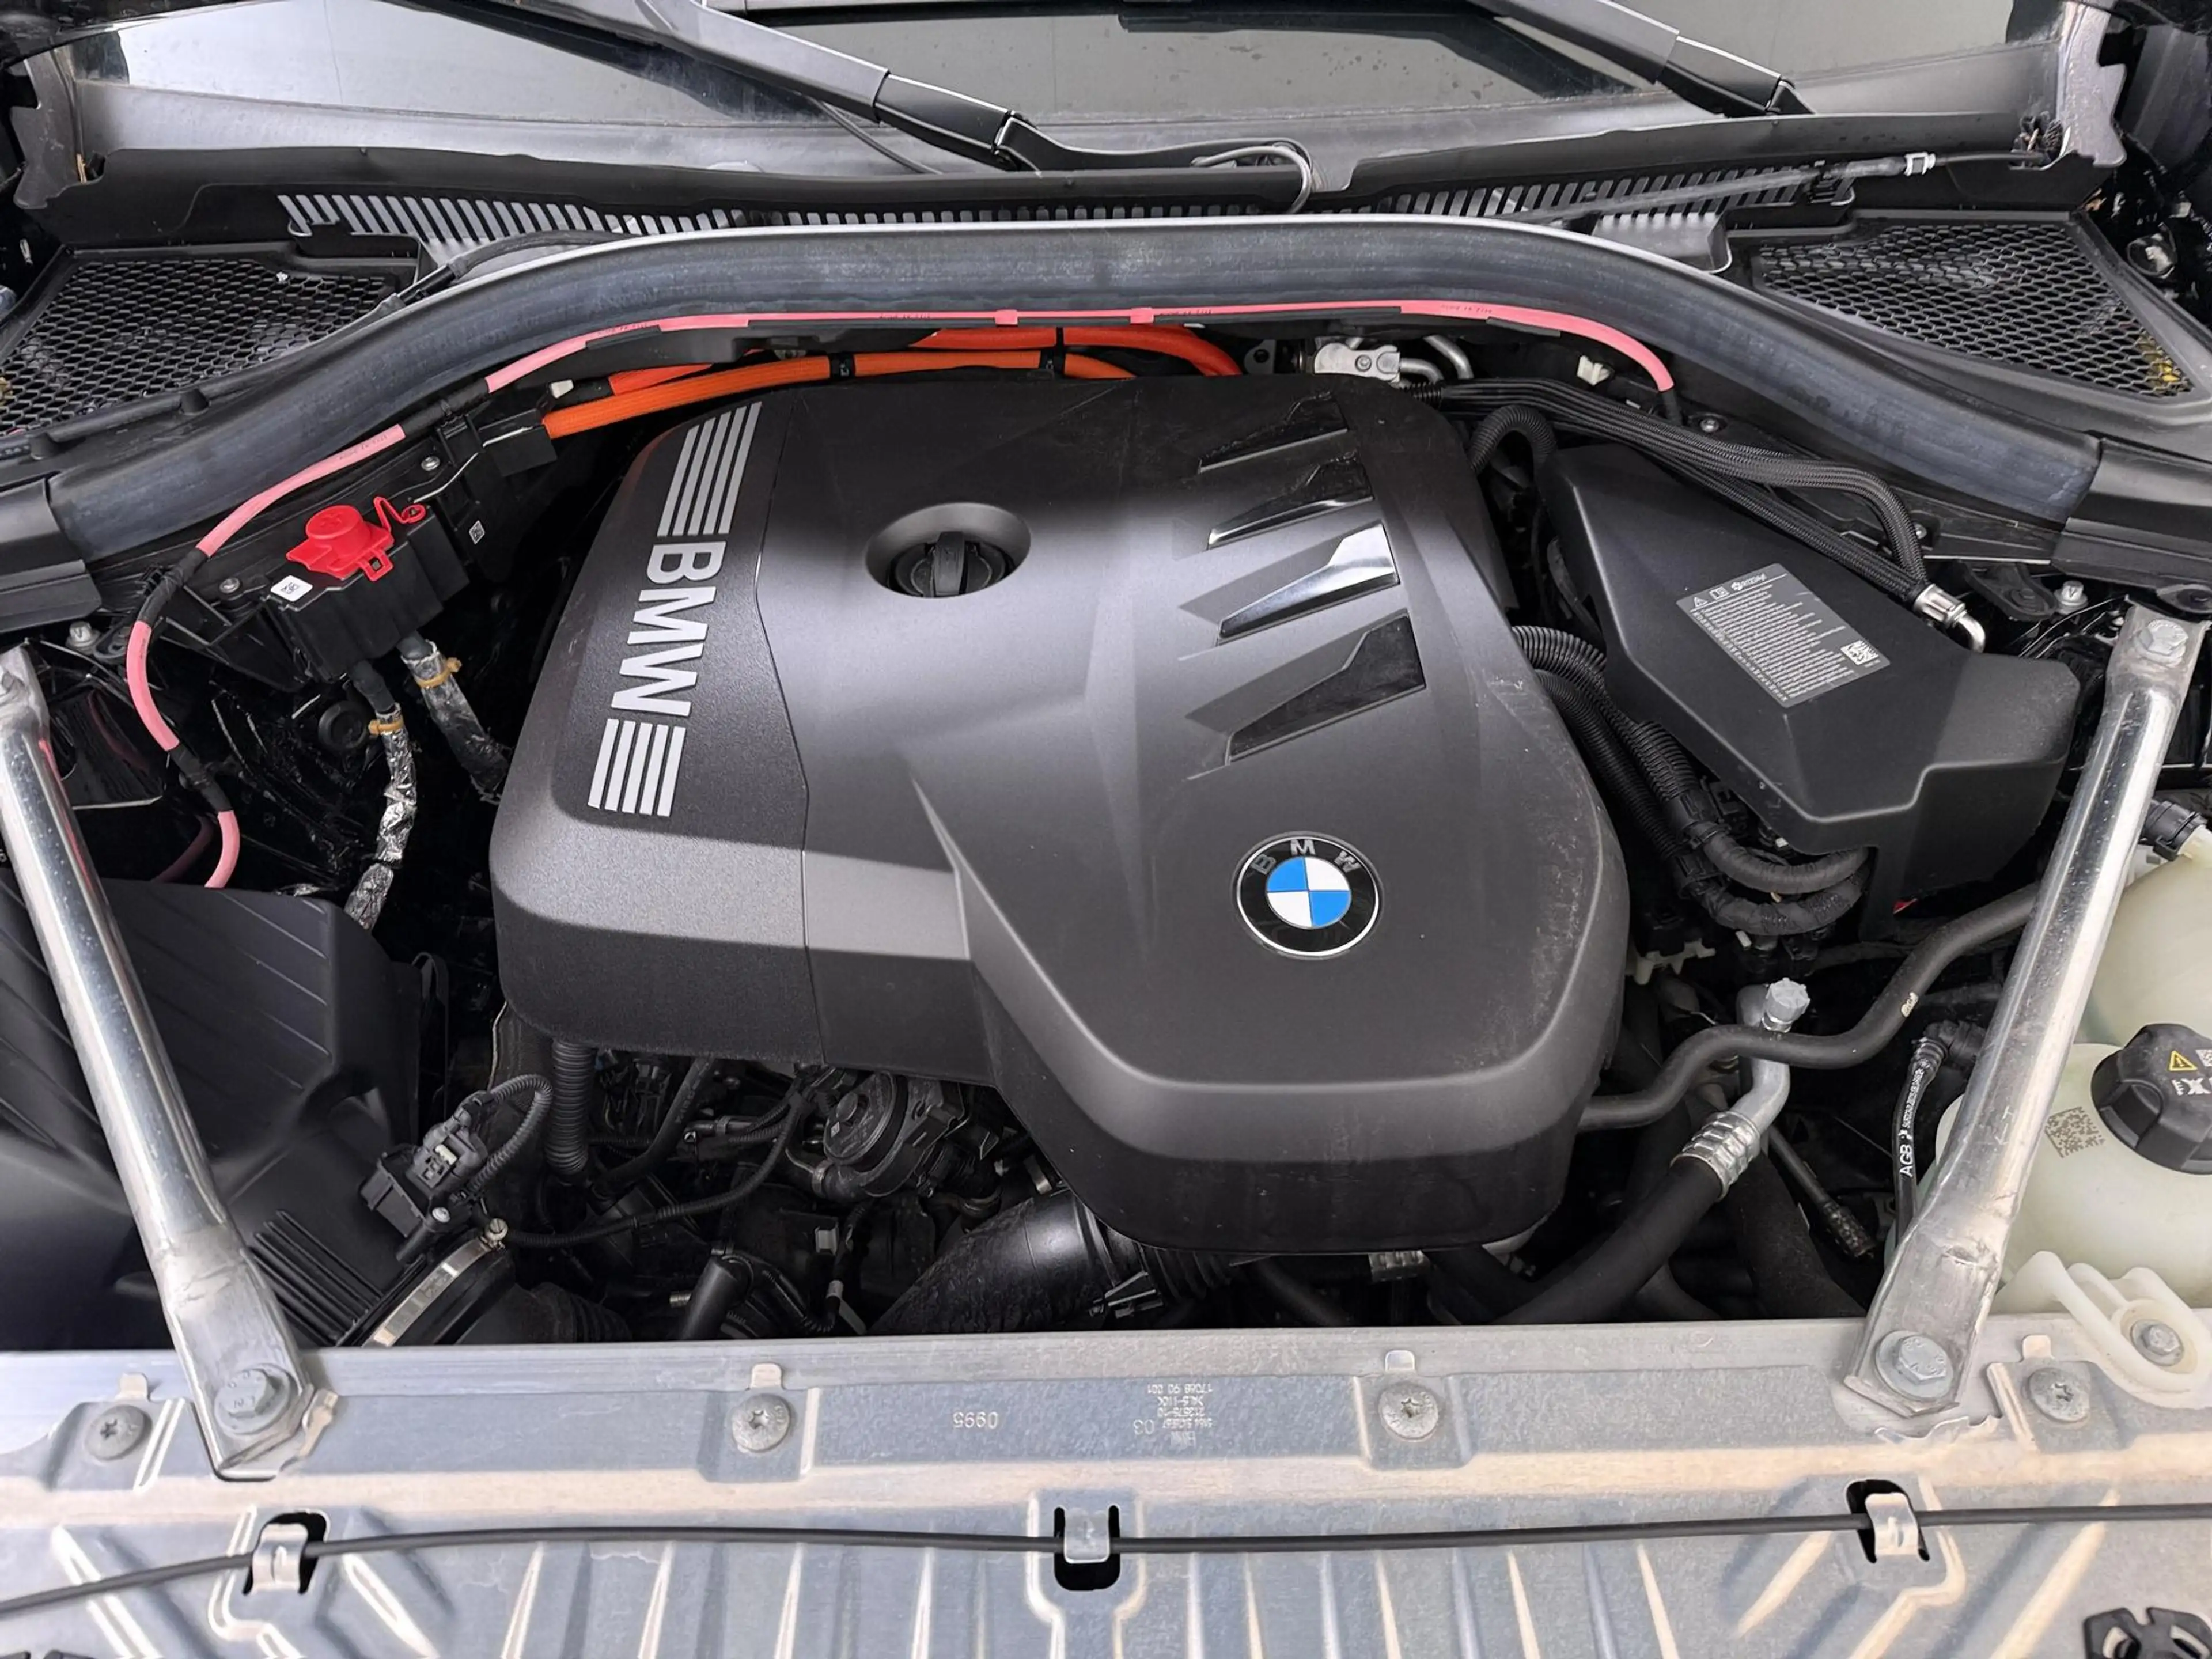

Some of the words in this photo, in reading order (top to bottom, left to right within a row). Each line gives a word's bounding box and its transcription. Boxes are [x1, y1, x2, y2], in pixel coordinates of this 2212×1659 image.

[611, 541, 726, 717] BMW
[1251, 839, 1361, 875] BMW
[1899, 1144, 1914, 1177] AGB
[953, 1411, 999, 1429] 0995
